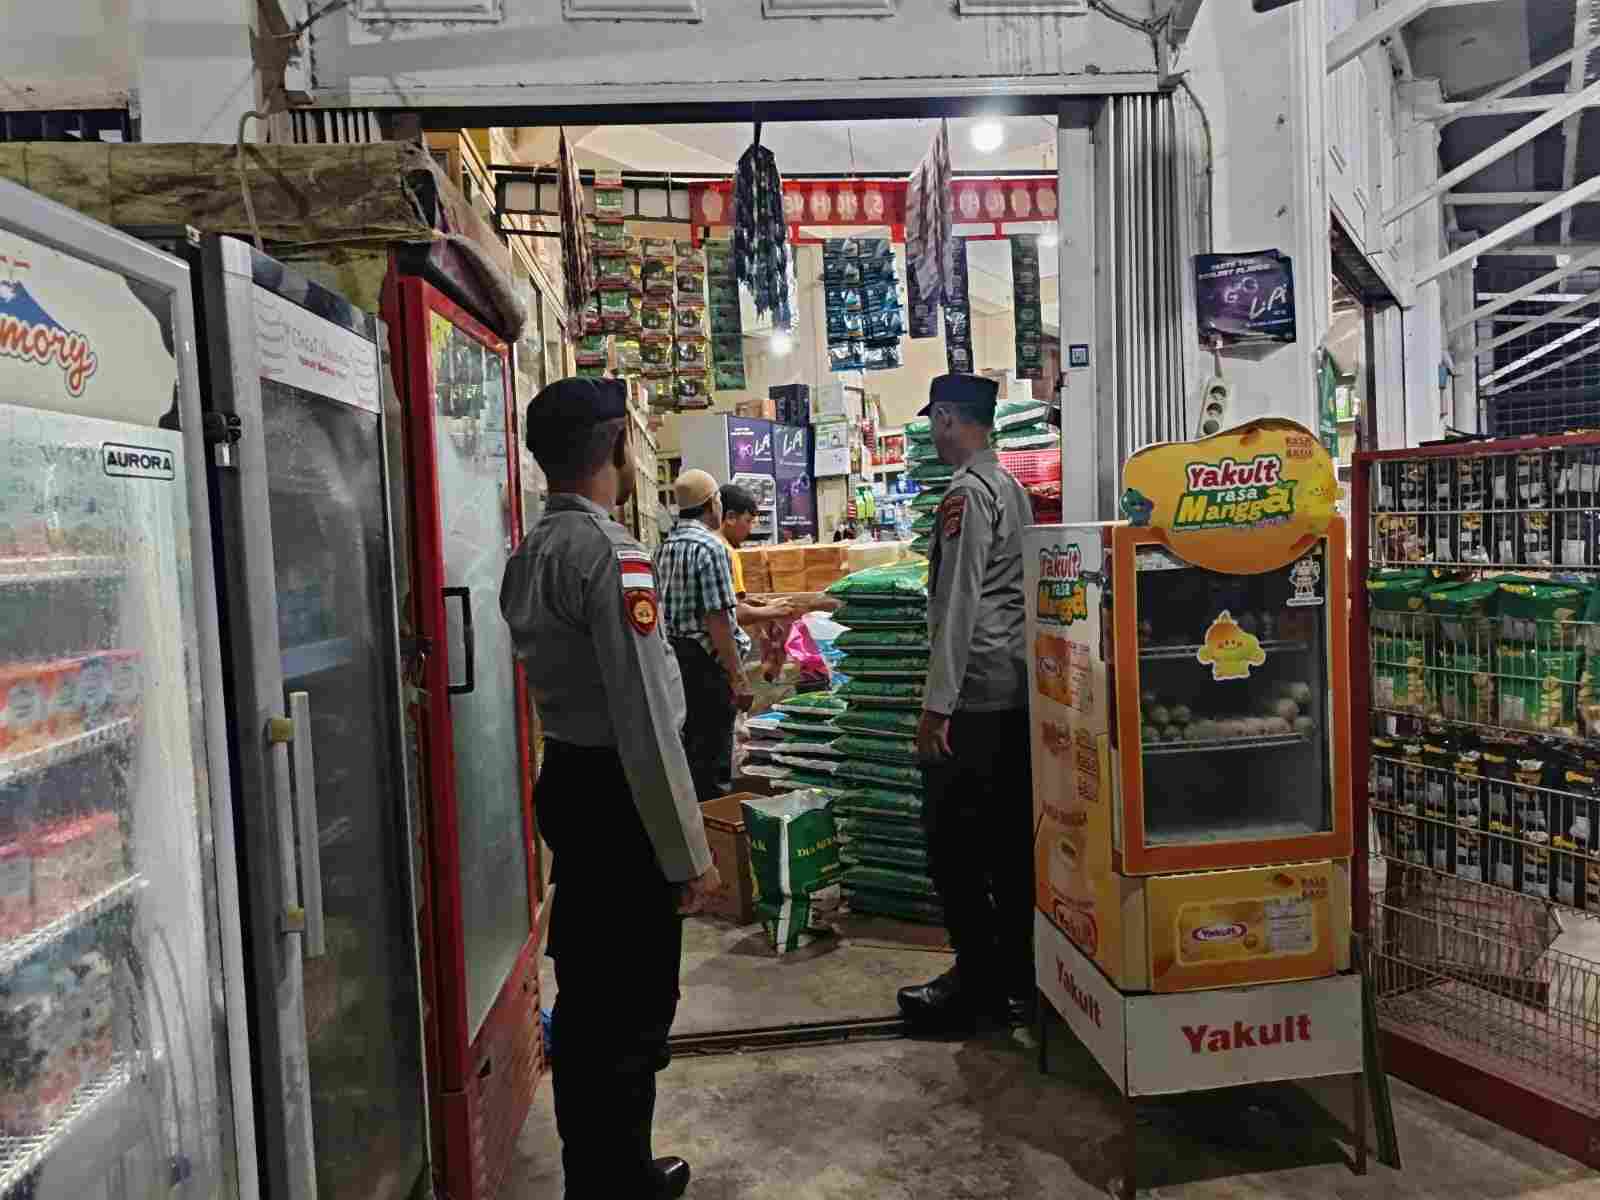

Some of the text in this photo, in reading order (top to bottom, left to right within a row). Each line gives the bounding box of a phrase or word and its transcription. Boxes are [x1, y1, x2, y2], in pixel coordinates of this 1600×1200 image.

[107, 451, 172, 471] AURORA
[1189, 459, 1279, 489] Yakult
[1176, 484, 1291, 523] Mangga
[1217, 488, 1257, 503] rasa
[1055, 954, 1102, 1029] Yakult
[1181, 1013, 1313, 1054] Yakult
